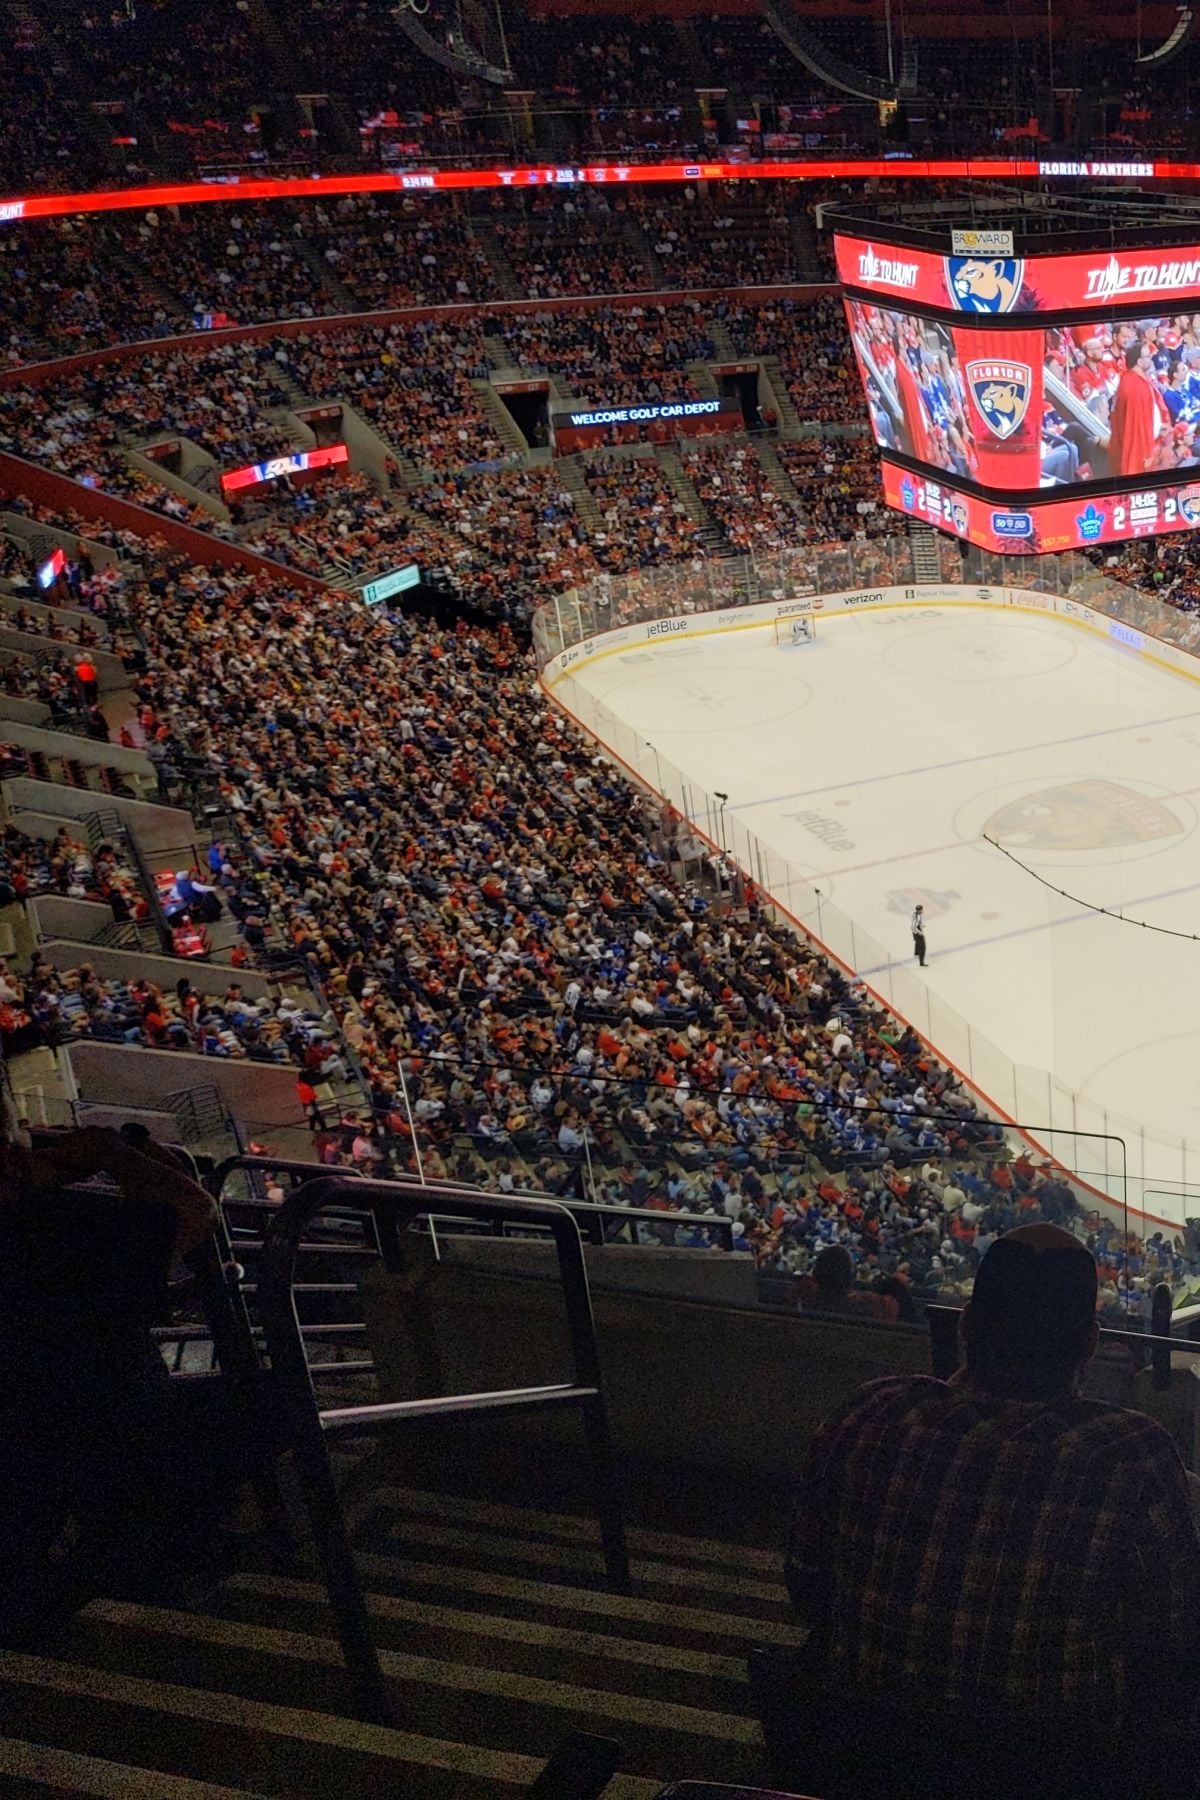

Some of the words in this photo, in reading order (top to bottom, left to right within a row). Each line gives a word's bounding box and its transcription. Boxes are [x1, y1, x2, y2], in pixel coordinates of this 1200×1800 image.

[1039, 162, 1088, 175] FLORIDA
[1091, 163, 1154, 177] PANTHERS
[954, 233, 1010, 245] BROWARD
[859, 243, 880, 280] TIME
[880, 260, 893, 280] TO
[892, 263, 919, 286] HUNT
[1086, 256, 1131, 294] TIME
[1134, 265, 1158, 287] TO
[973, 366, 1023, 380] FLORIDA
[571, 411, 628, 425] WELCOME
[629, 407, 660, 420] GOLF
[661, 404, 684, 417] CAR
[685, 401, 720, 414] DEPOT
[918, 488, 926, 511] 2
[943, 499, 952, 522] 2
[1130, 492, 1157, 509] 14:02
[1165, 498, 1177, 522] 2
[1113, 506, 1126, 530] 2
[777, 603, 811, 616] guaranteed
[843, 592, 883, 605] verizon
[646, 620, 688, 638] jetBlue
[782, 808, 856, 852] jetBlue
